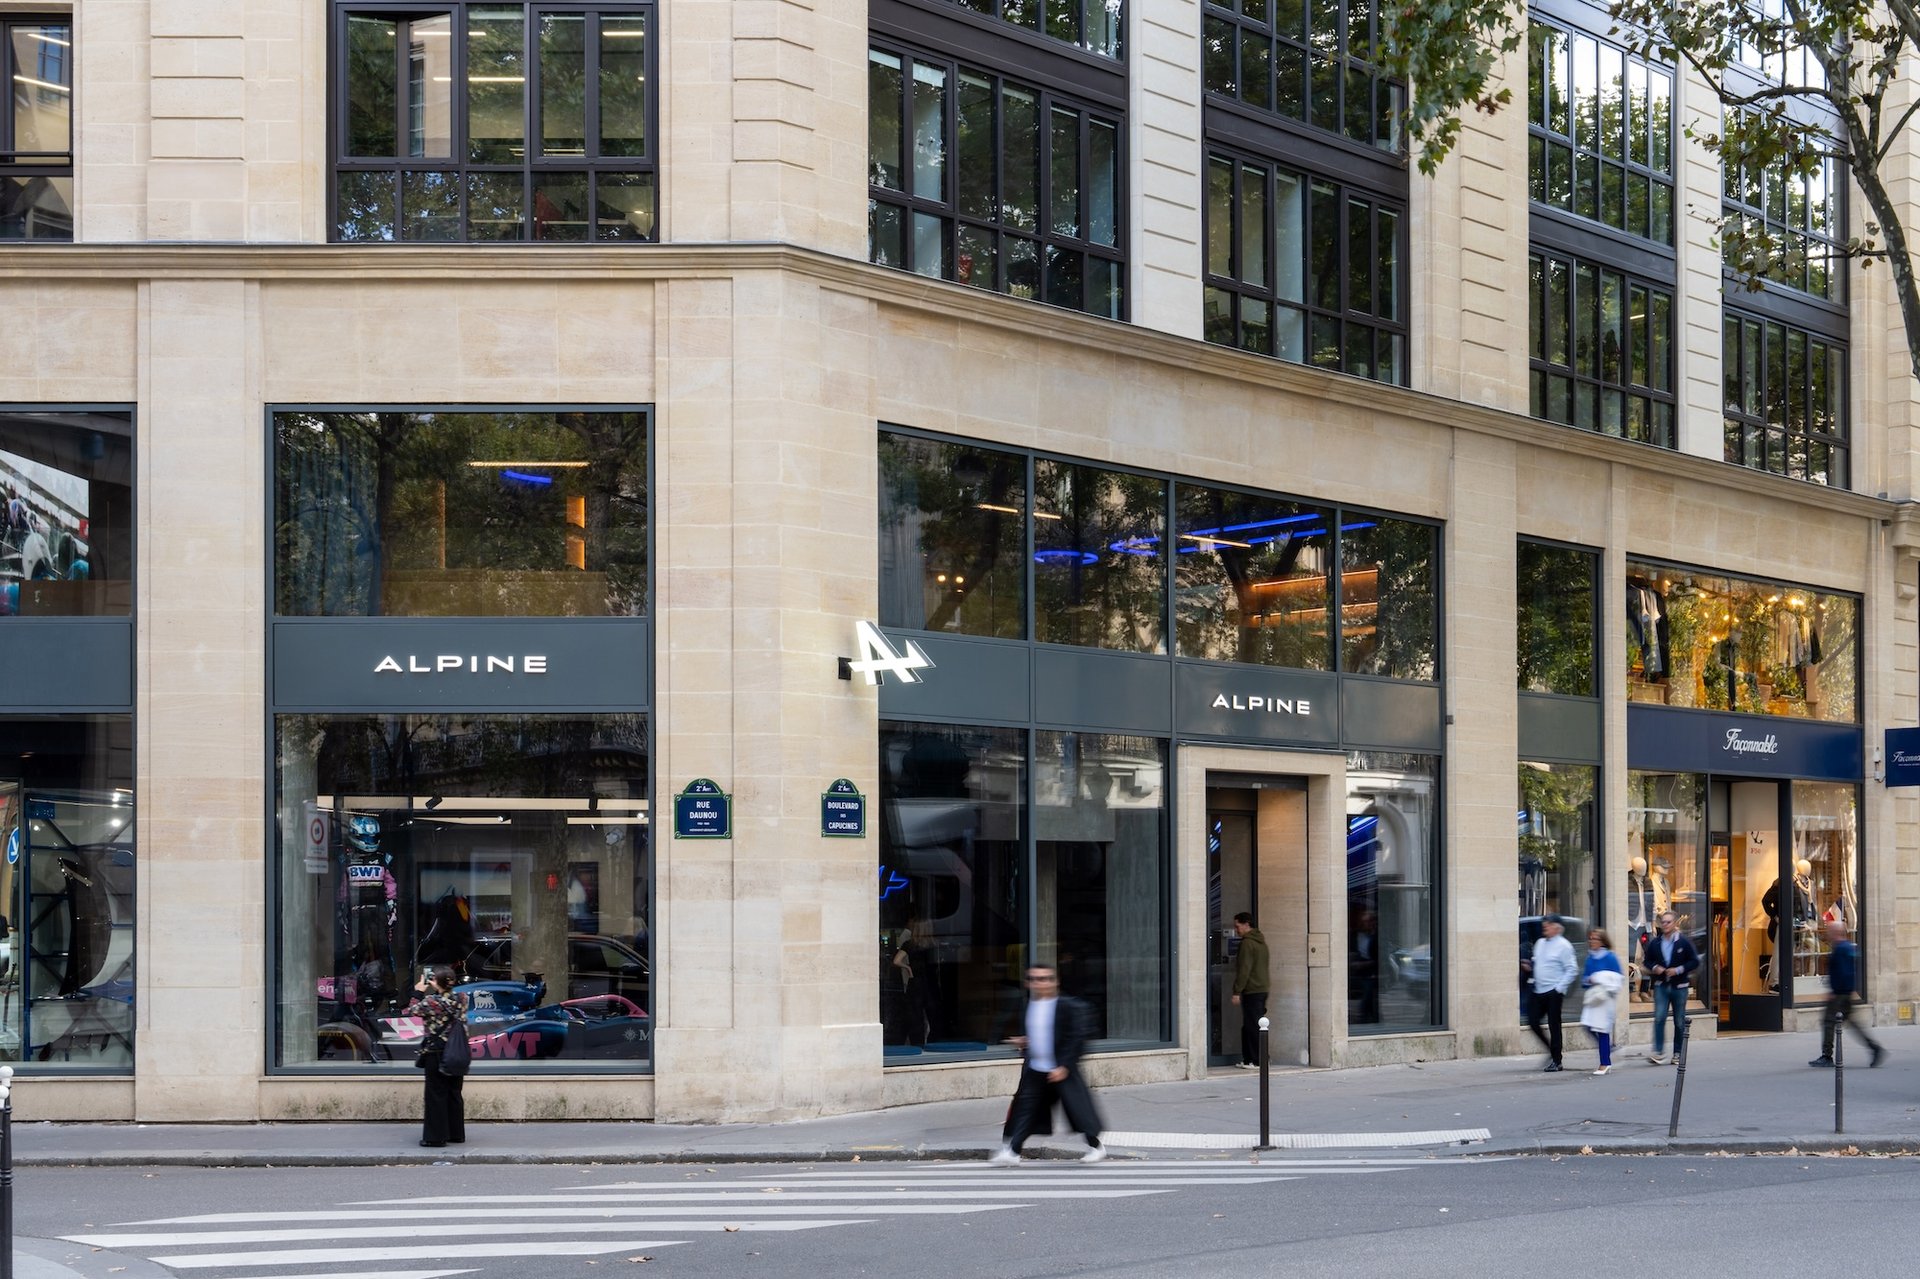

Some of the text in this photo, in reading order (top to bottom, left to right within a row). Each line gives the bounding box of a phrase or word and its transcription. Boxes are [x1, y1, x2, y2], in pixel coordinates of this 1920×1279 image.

[374, 655, 547, 673] ALPINE
[1212, 693, 1310, 715] ALPINE
[1723, 728, 1778, 754] Façonnable
[696, 801, 710, 809] RUE
[827, 801, 859, 810] BOULEVARD
[689, 811, 718, 819] DAUNOU
[828, 821, 858, 830] CAPUCINES
[350, 866, 381, 877] BWT
[468, 1032, 541, 1058] BWT
